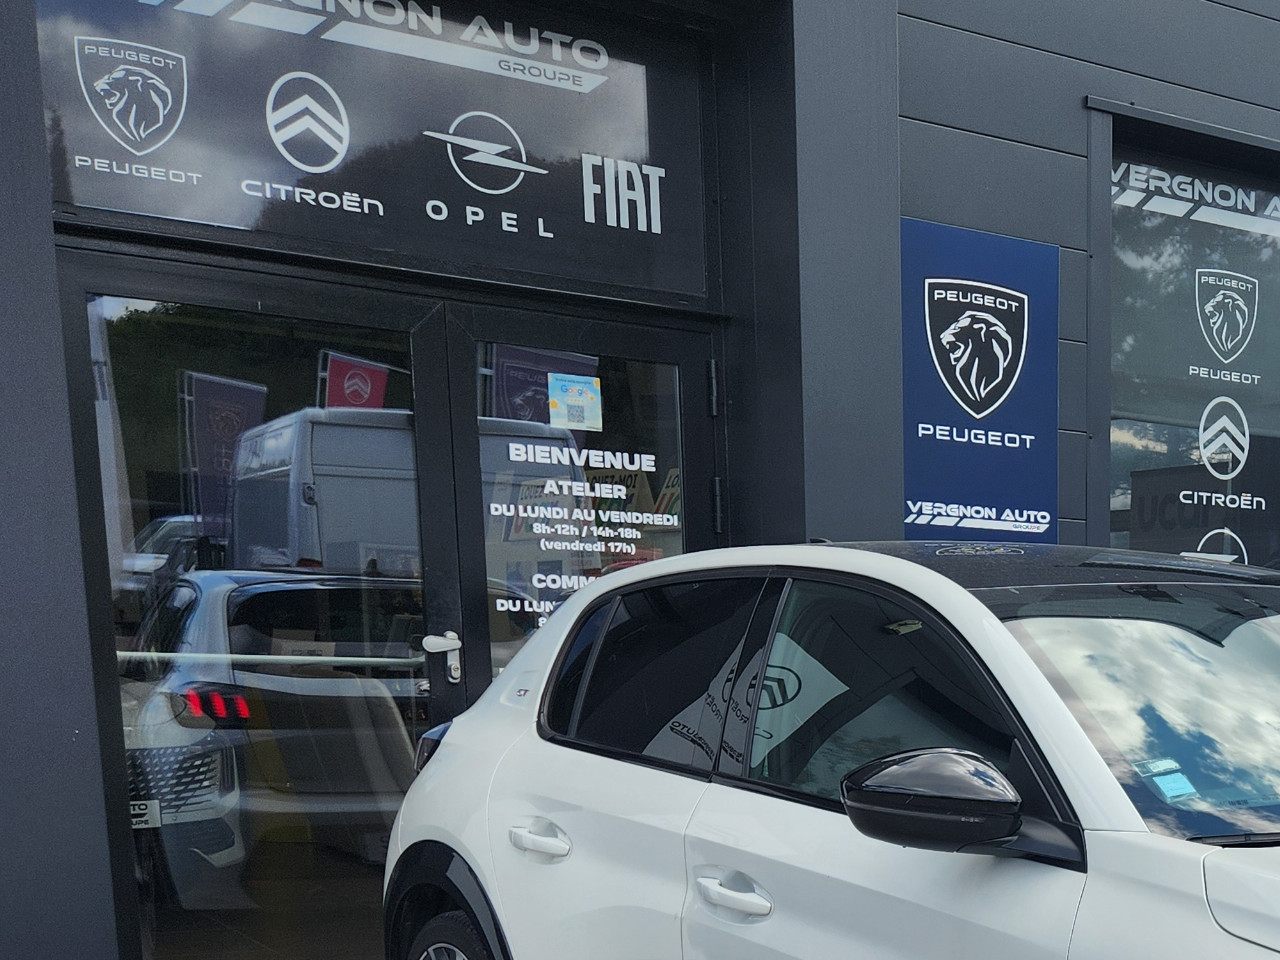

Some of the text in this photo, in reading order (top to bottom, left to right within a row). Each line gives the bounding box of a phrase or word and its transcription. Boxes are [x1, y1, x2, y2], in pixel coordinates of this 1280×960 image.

[276, 0, 609, 70] NON AUTO
[84, 45, 178, 70] PEUGEOT
[498, 59, 584, 87] GROUPE
[75, 155, 203, 185] PEUGEOT
[581, 153, 666, 234] FIAT
[1111, 162, 1256, 212] VERGNON
[426, 199, 554, 238] OPEL
[1201, 275, 1253, 292] PEUGEOT
[934, 289, 1019, 313] PEUGEOT
[1189, 365, 1261, 385] PEUGEOT
[918, 423, 1036, 449] PEUGEOT
[508, 443, 657, 472] BIENVENUE
[544, 480, 627, 500] ATELIER
[490, 503, 679, 526] DU LUNDI AU VENDREDI
[906, 500, 1051, 524] VERGNON AUTO
[532, 524, 580, 536] 8h-12h
[590, 526, 642, 540] 14h-18h
[540, 538, 637, 556] (vendredi 17h)
[532, 573, 600, 589] COMM
[496, 599, 521, 612] DU
